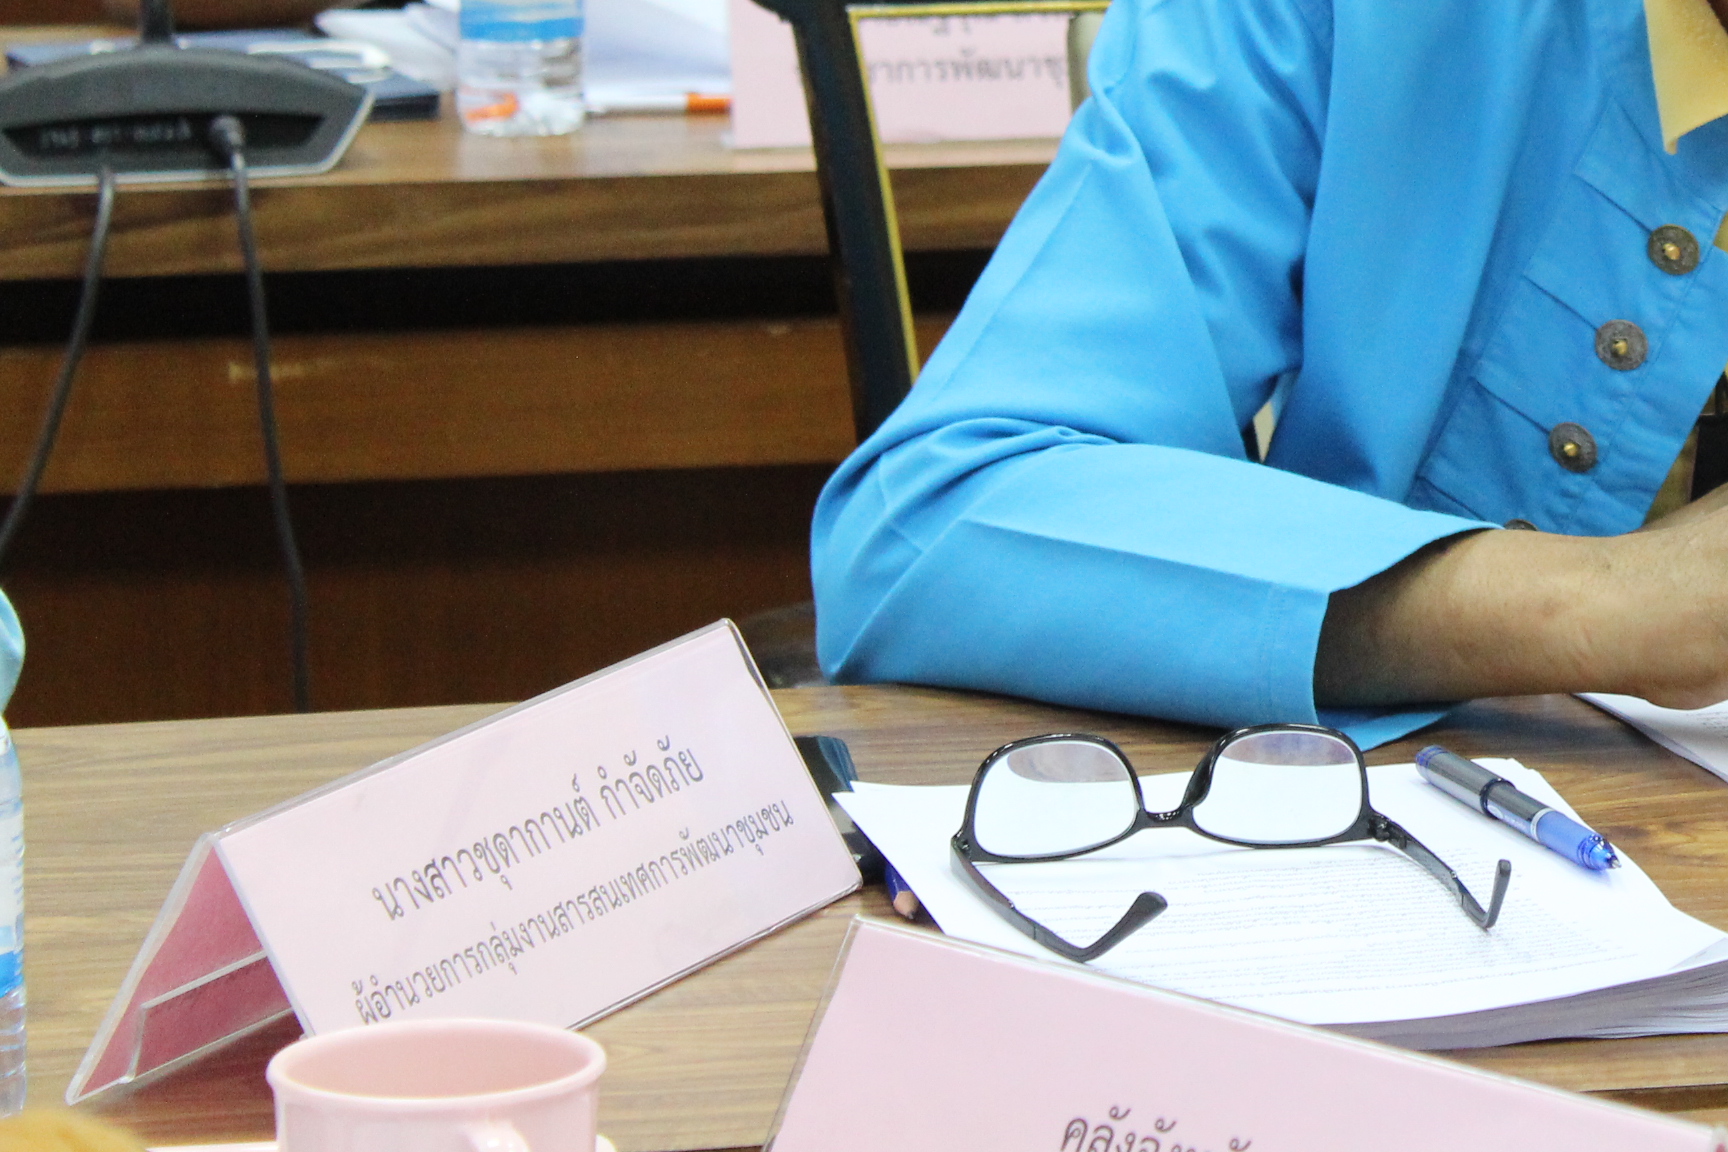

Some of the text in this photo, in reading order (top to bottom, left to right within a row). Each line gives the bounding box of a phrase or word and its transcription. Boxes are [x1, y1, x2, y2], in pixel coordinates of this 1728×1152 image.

[351, 799, 795, 1026] ผ้อำนวยการกลุ่มงานสารสนเทศการพัฒนาชุมชน
[371, 734, 704, 921] นางสาวชุดากานต์ กำจัดภัย
